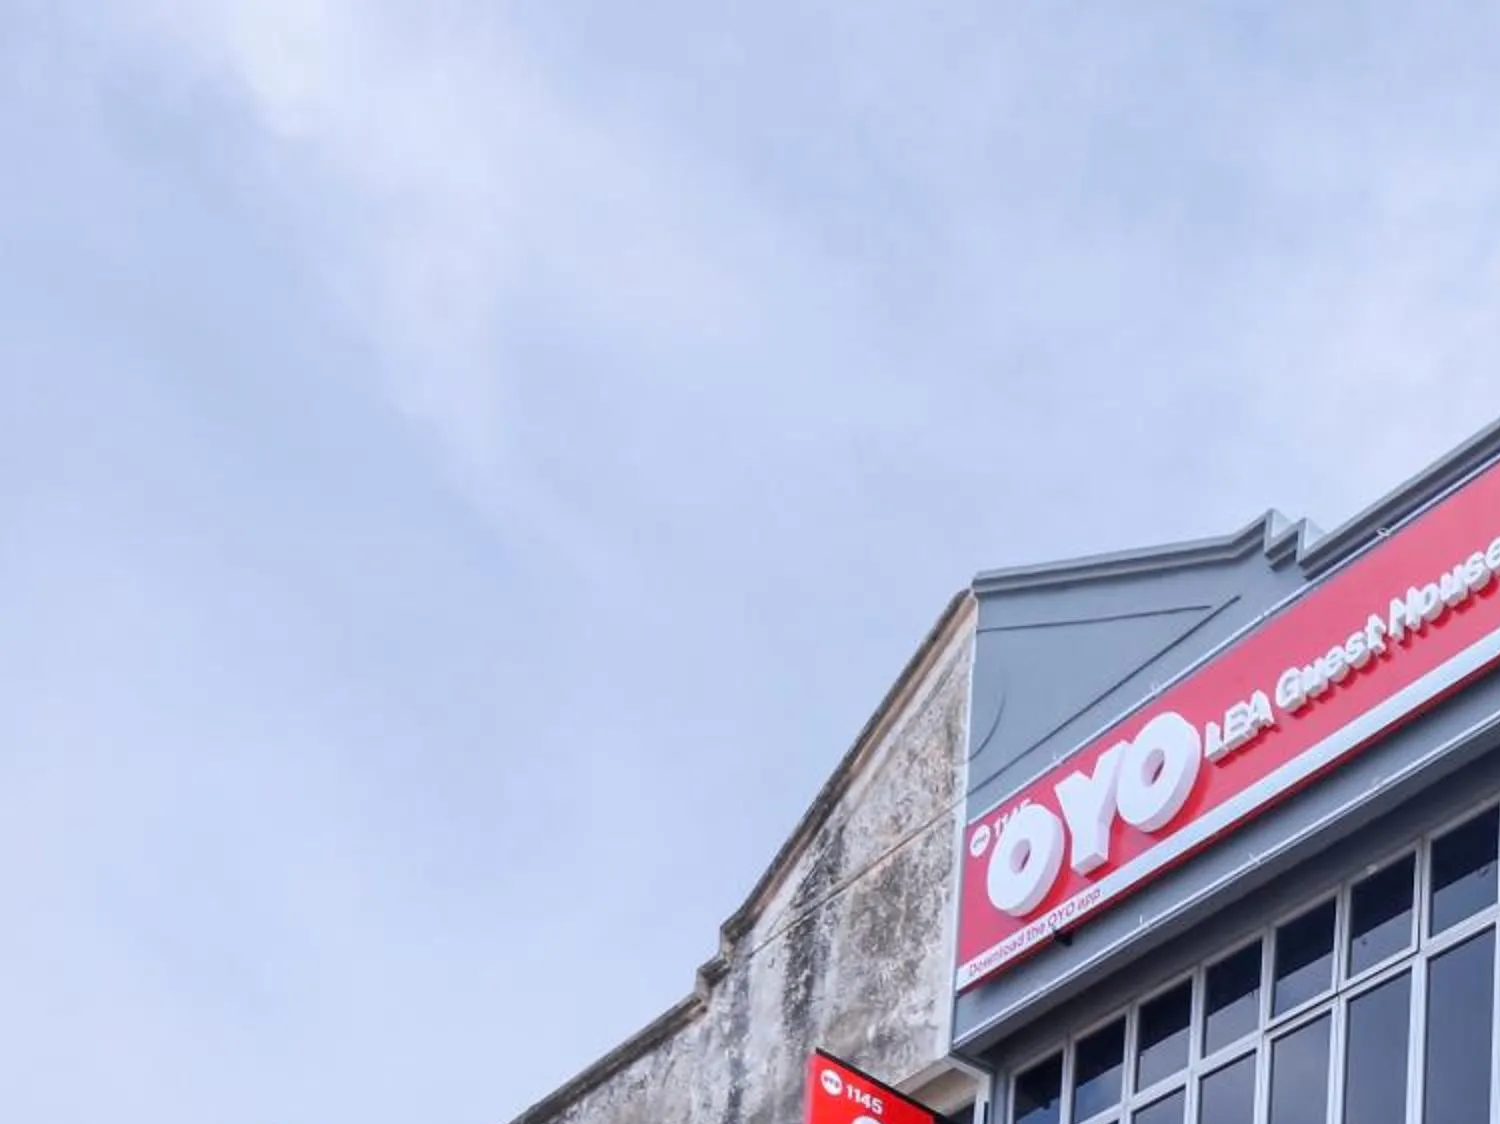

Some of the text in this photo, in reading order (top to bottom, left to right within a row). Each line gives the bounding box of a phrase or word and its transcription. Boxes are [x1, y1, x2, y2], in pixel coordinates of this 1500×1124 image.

[1204, 689, 1275, 762] LEA
[1275, 613, 1388, 711] Guest
[987, 711, 1202, 917] OYO
[846, 1083, 883, 1116] 1145
